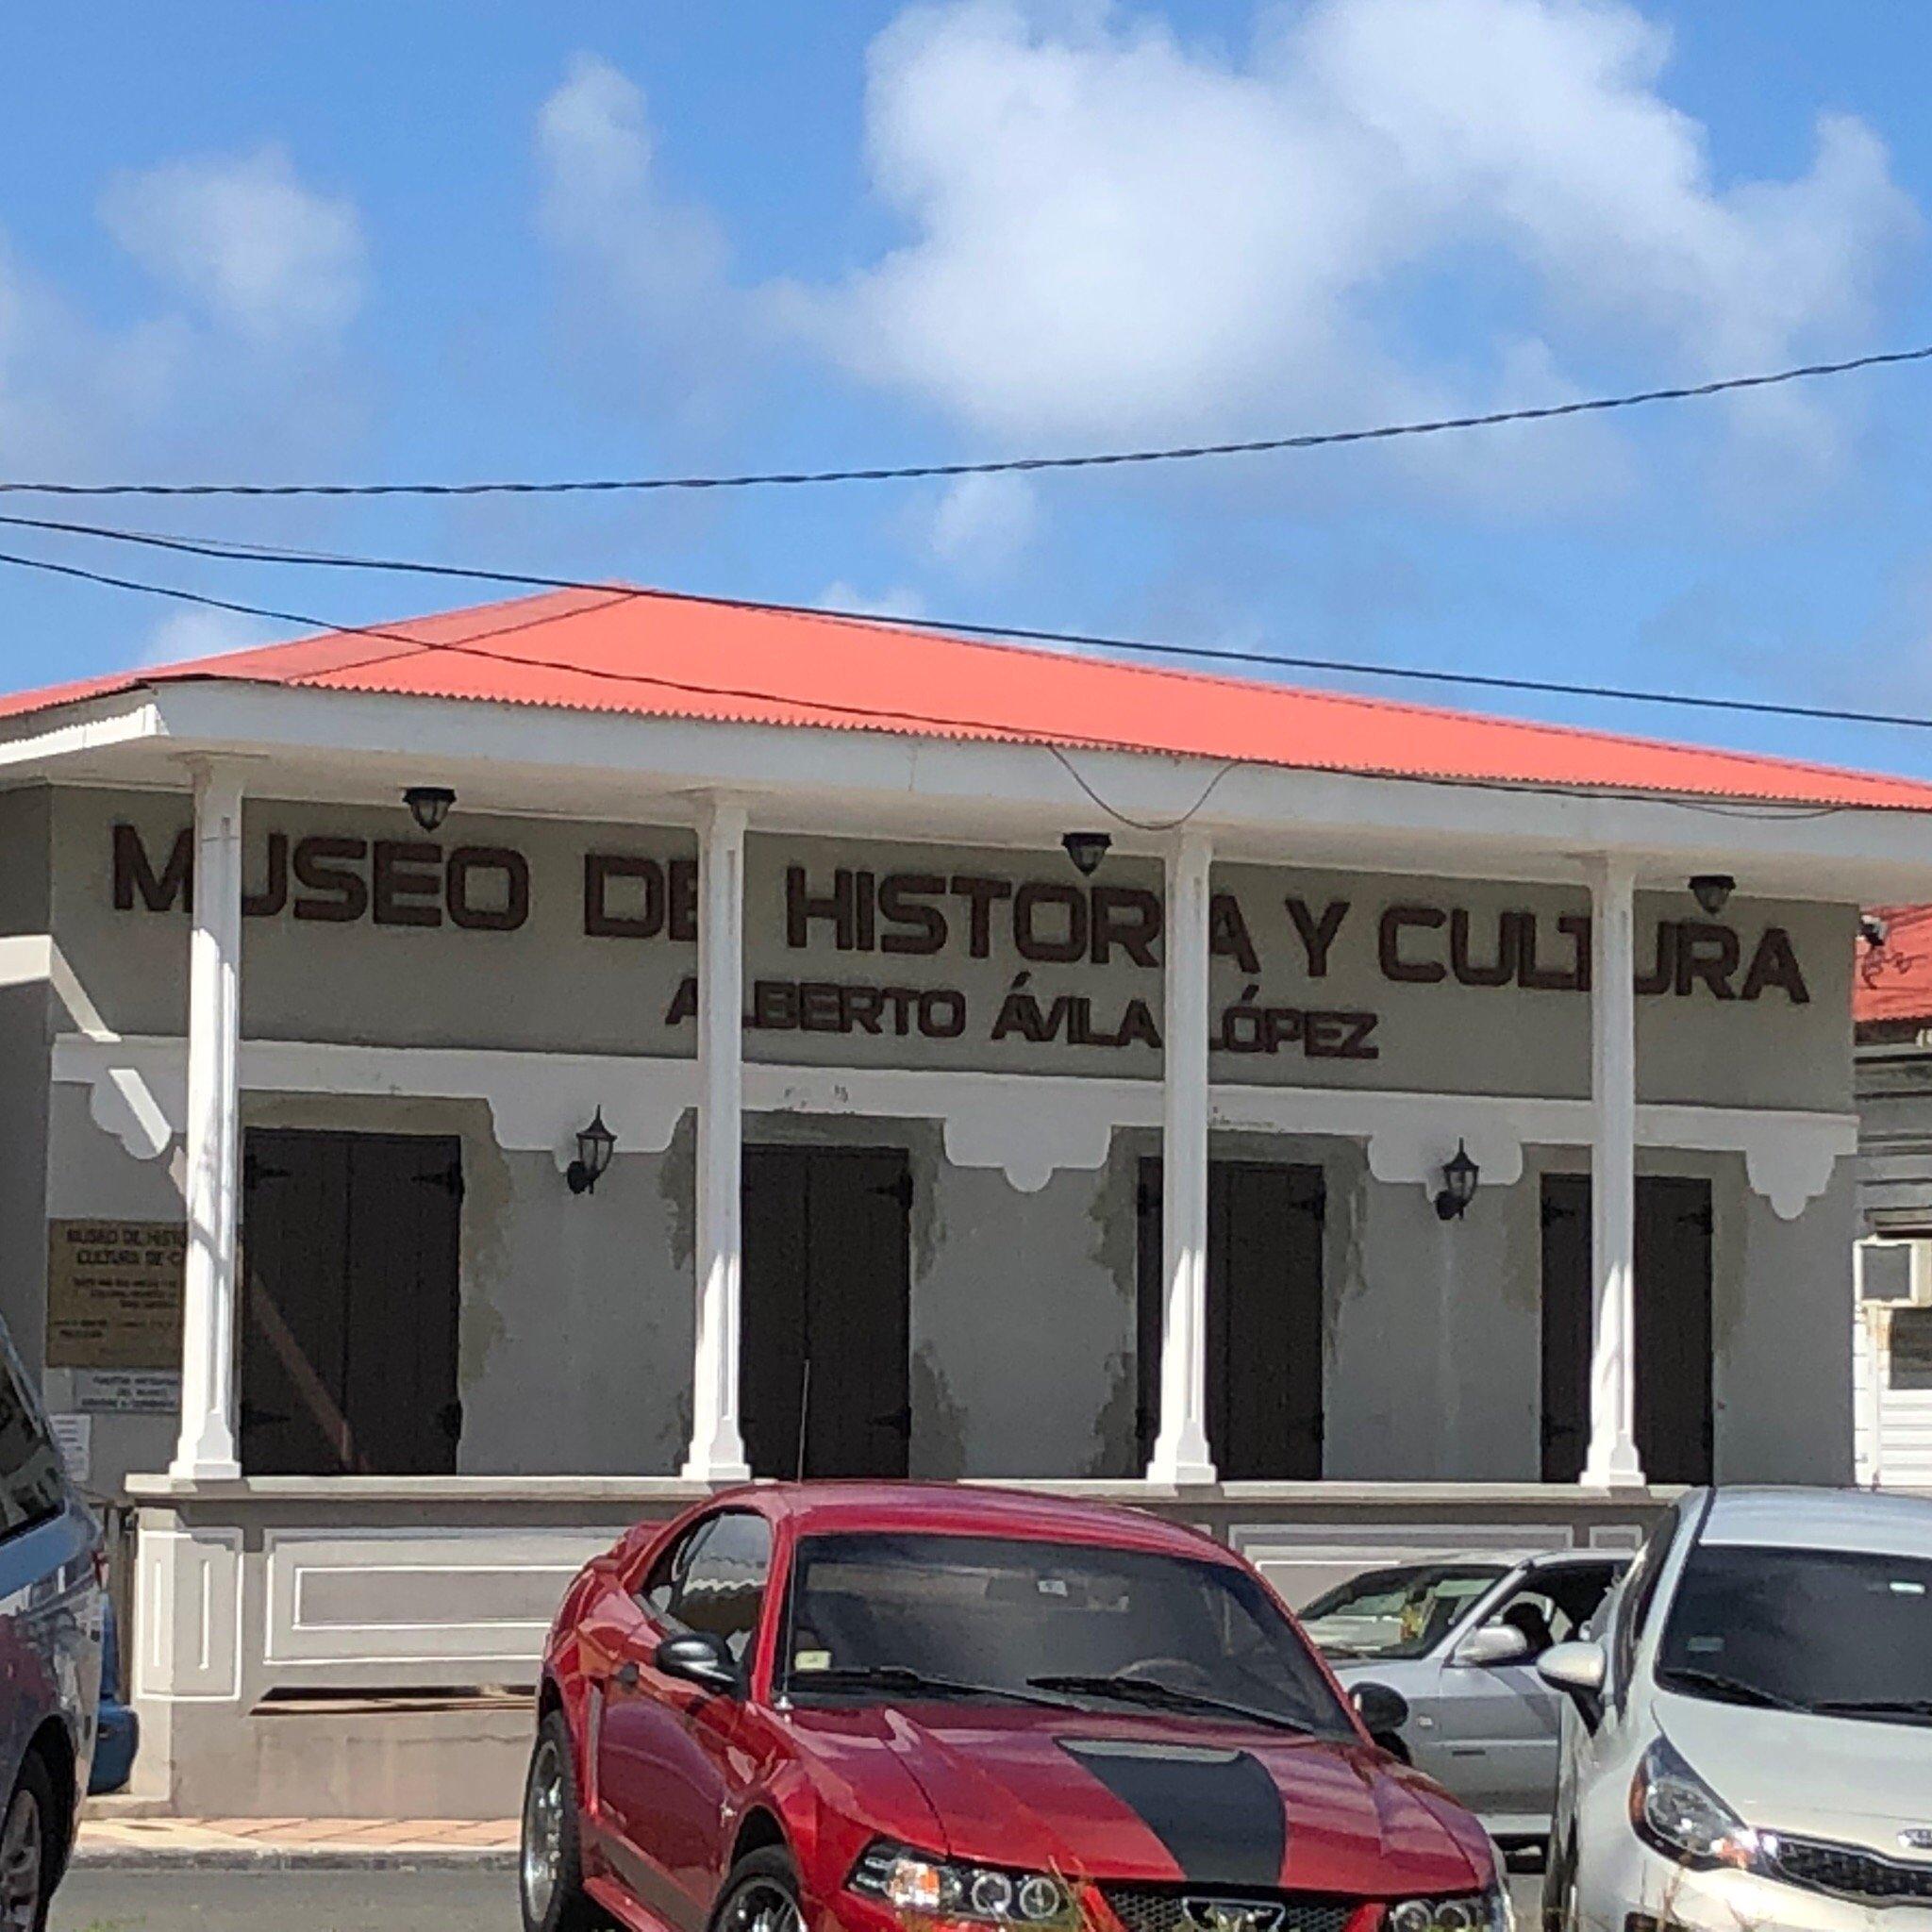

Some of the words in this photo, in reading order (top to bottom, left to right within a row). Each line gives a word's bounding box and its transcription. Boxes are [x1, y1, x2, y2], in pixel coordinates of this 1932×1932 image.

[786, 865, 1261, 974] HISTORA
[1285, 899, 1351, 976] Y
[664, 977, 966, 1038] ABERTO
[991, 971, 1163, 1049] ÁVILA
